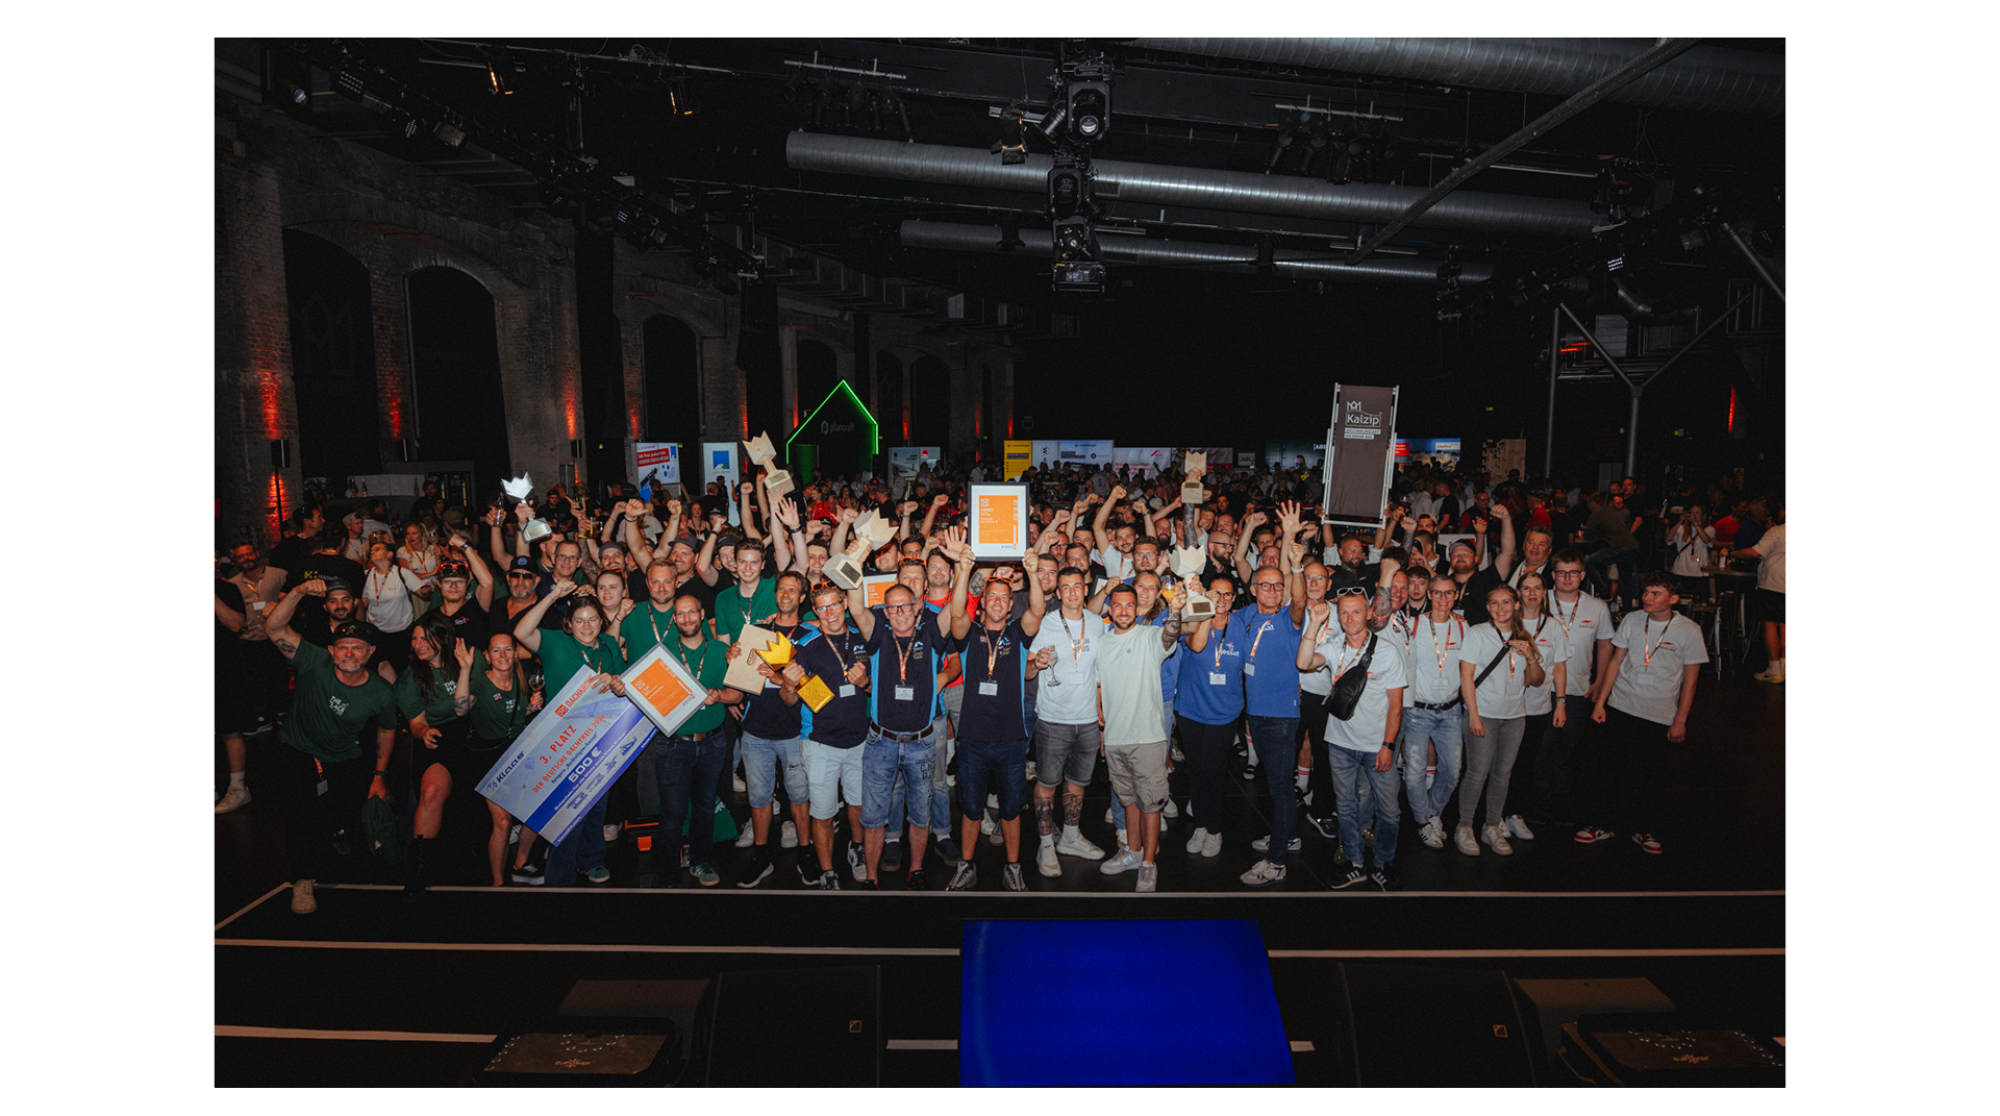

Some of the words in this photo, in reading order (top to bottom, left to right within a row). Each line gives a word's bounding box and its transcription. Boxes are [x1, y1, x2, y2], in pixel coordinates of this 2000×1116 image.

[1347, 413, 1379, 427] Kalzip
[531, 780, 544, 793] DER
[541, 754, 568, 782] DEUTSCHE
[565, 726, 593, 756] DACHPREIS
[590, 713, 605, 728] 2026
[538, 751, 552, 764] 3.
[549, 724, 577, 753] PLATZ
[497, 750, 525, 783] Klaas
[567, 755, 593, 783] 500
[589, 746, 602, 758] €
